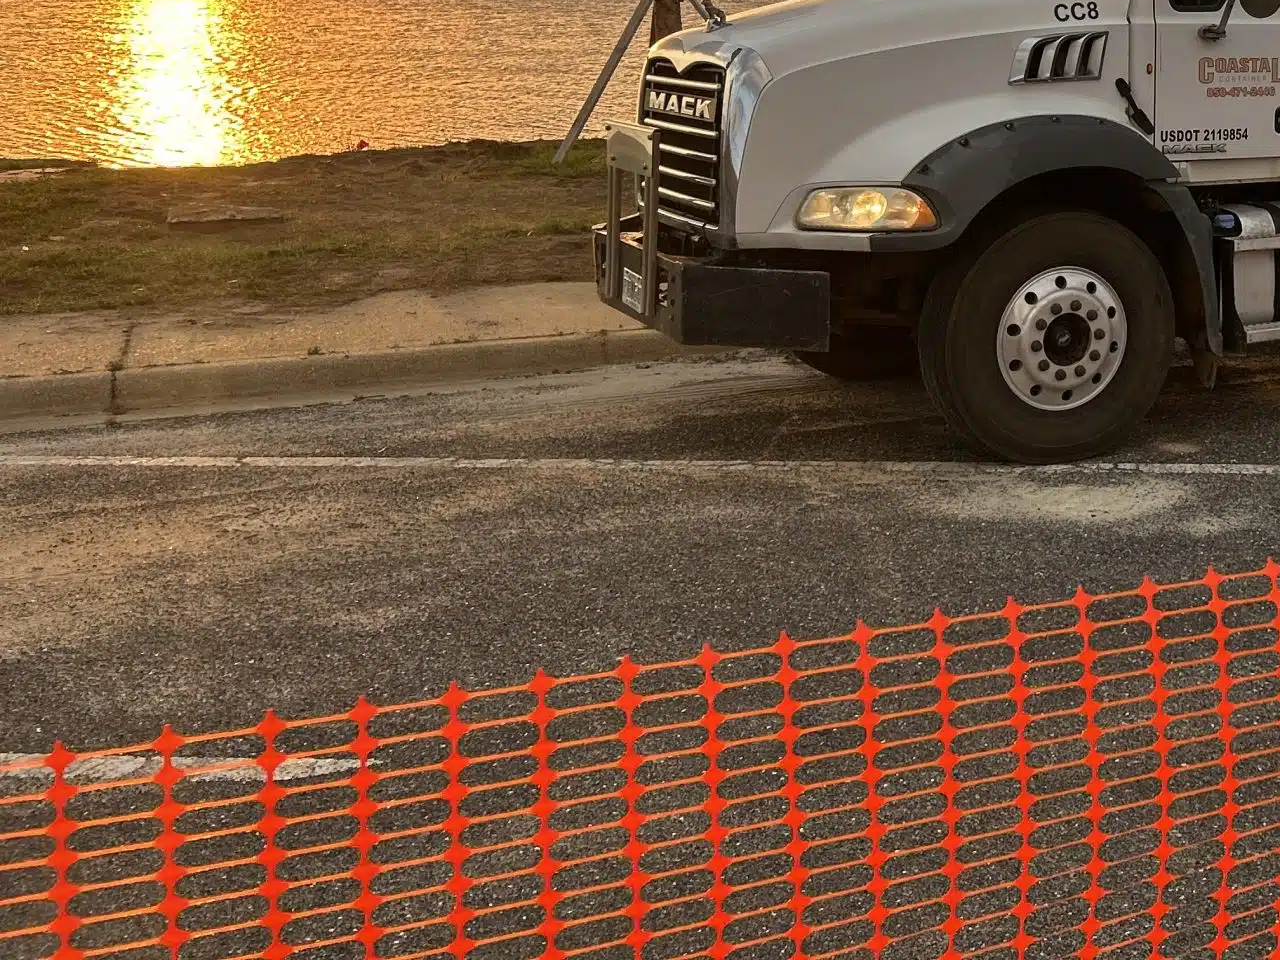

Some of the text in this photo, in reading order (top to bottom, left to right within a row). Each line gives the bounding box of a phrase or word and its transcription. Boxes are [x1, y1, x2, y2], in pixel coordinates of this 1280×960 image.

[1054, 1, 1099, 22] CC8
[649, 91, 712, 119] MACK
[1160, 128, 1249, 142] USDOT 2119854
[1162, 143, 1227, 154] MACK
